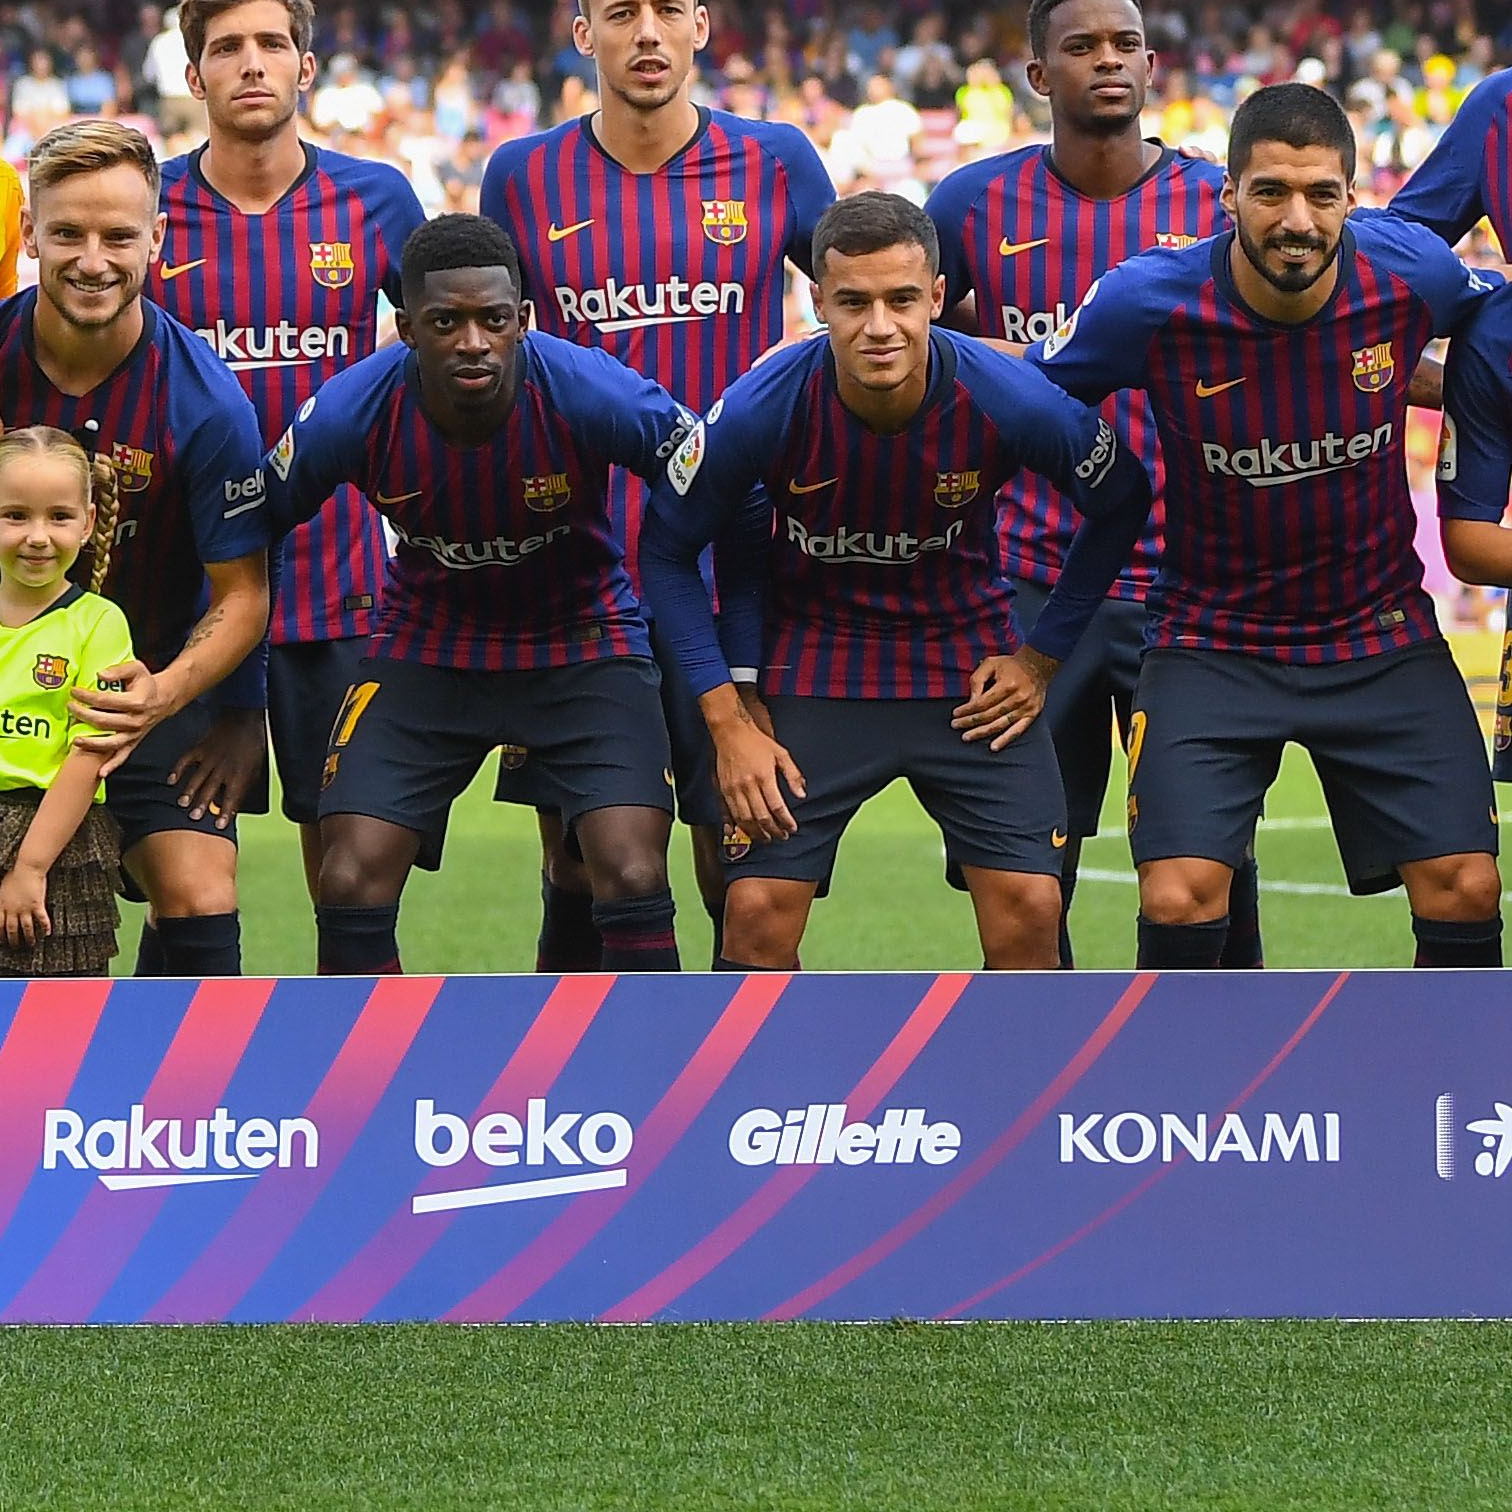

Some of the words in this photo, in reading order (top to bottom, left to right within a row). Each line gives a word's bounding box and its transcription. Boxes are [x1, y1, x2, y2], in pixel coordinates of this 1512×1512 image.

[554, 276, 745, 324] Rakuten
[1202, 423, 1393, 478] Rakuten
[391, 521, 571, 564] Rakuten
[787, 515, 963, 559] Rakuten
[43, 1104, 319, 1178] Rakuten
[412, 1099, 633, 1178] beko
[728, 1103, 962, 1166] Gillette
[1058, 1112, 1342, 1163] KONAMI
